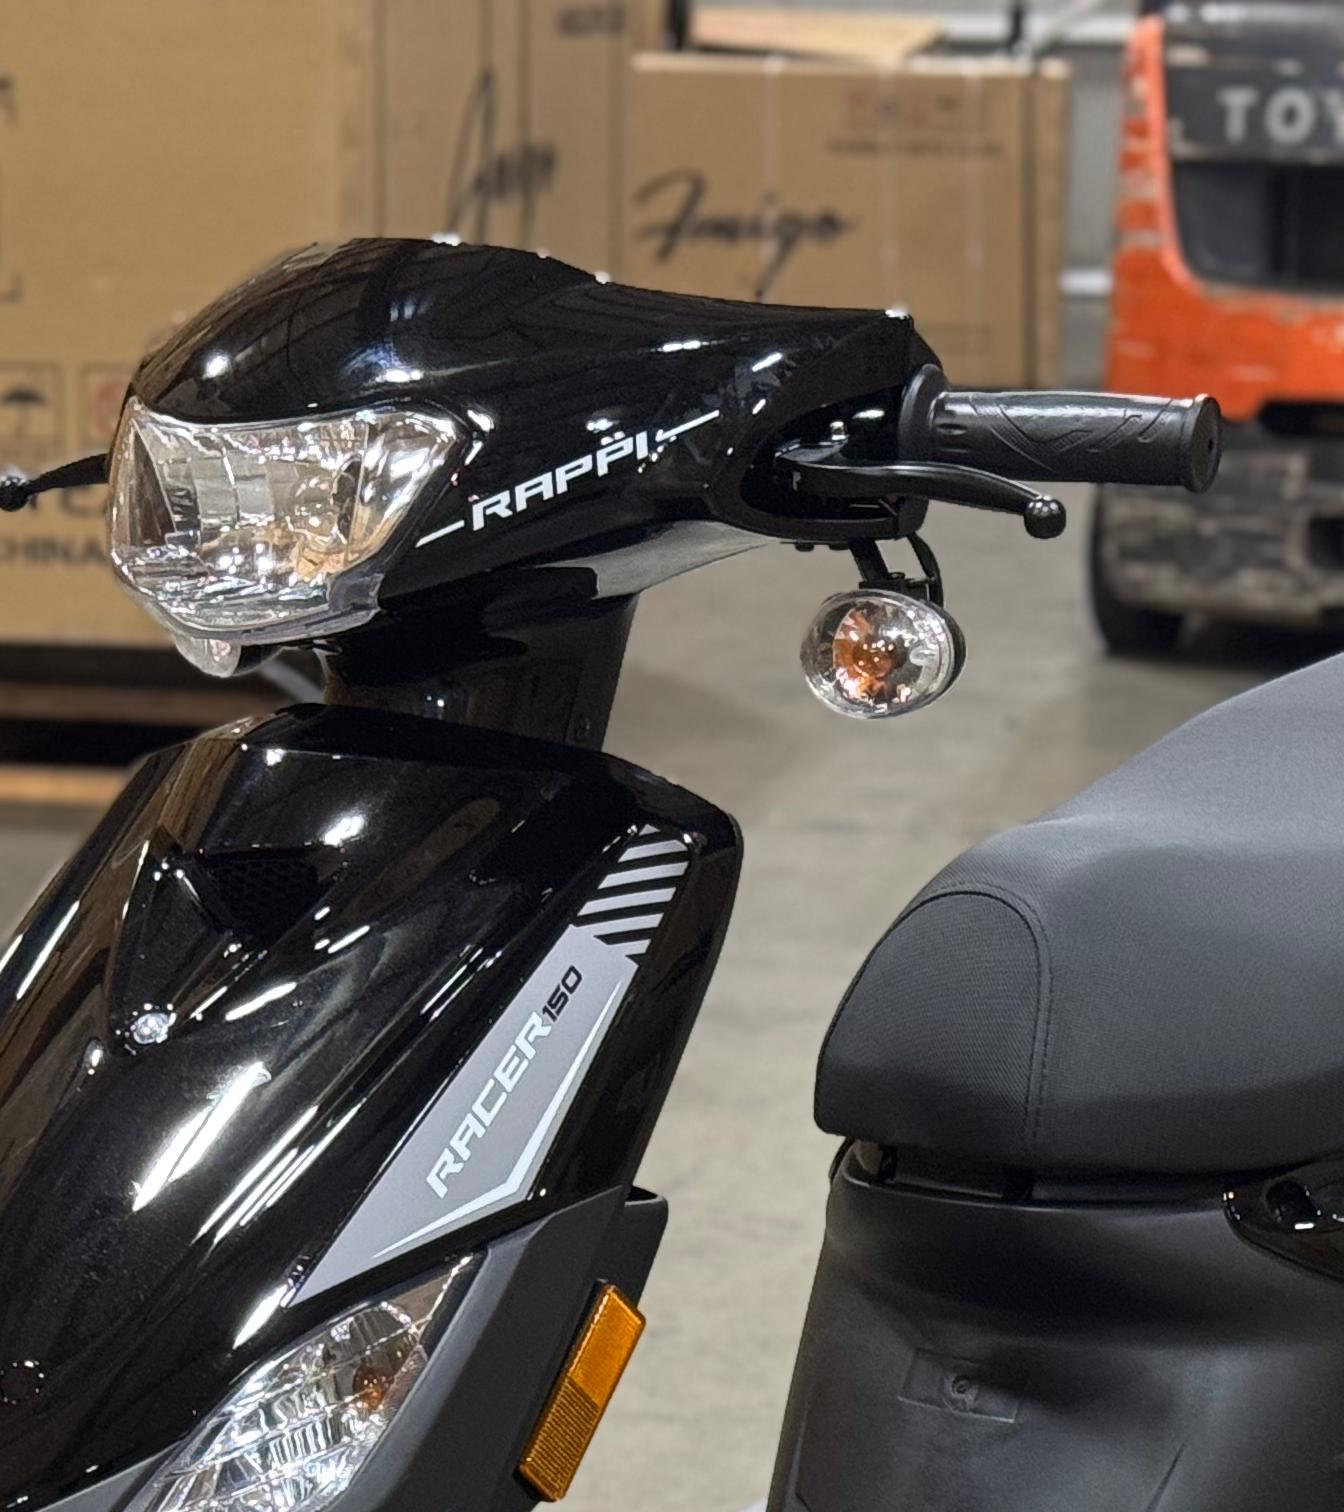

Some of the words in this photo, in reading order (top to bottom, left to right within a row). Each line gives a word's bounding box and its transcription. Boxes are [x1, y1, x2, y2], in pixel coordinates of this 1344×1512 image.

[471, 431, 649, 531] RAPPI
[425, 1010, 552, 1200] RACER
[542, 965, 583, 1022] 150
